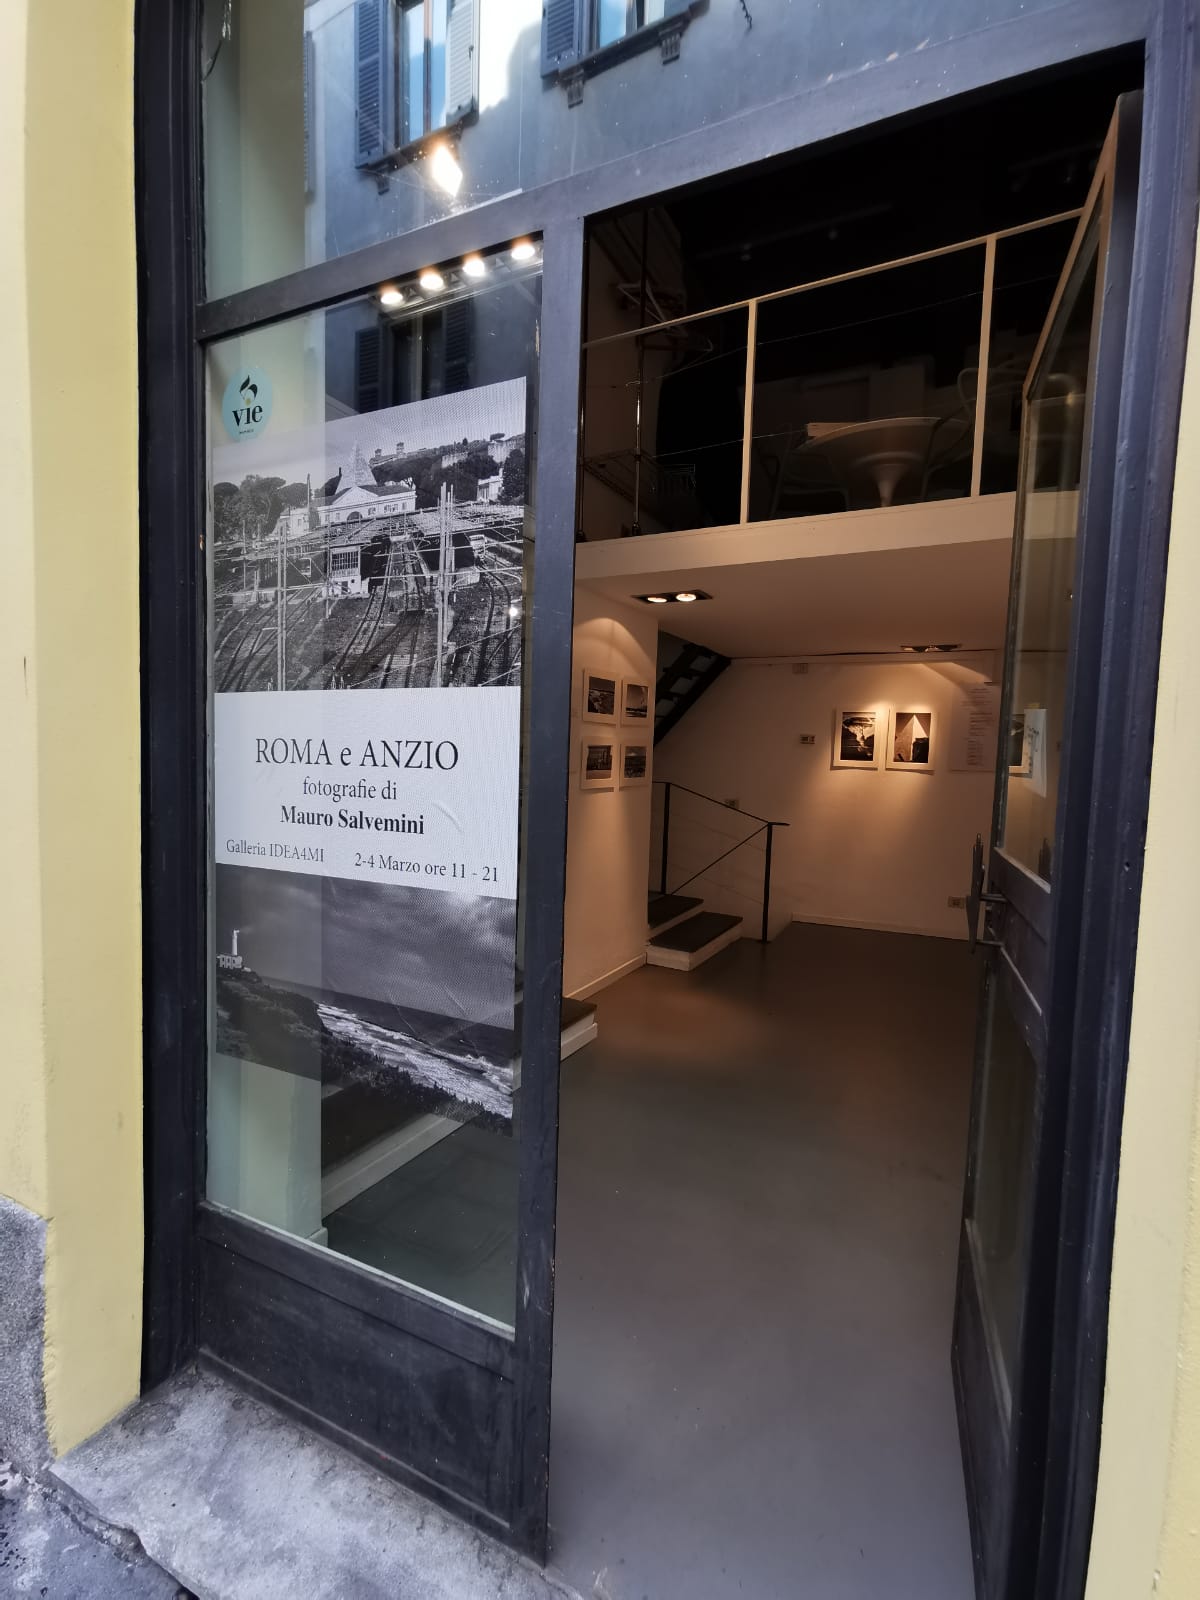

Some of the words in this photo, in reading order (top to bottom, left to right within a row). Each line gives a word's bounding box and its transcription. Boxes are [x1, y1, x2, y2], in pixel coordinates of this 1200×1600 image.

[255, 737, 333, 766] ROMA
[340, 746, 352, 766] e
[359, 739, 459, 770] ANZIO
[303, 776, 377, 802] fotografie
[381, 780, 397, 800] di
[280, 805, 333, 827] Mauro
[338, 808, 425, 835] Salvemini
[226, 839, 266, 857] Galleria
[269, 843, 324, 862] IDEA4MI
[354, 852, 375, 868] 2-4
[378, 854, 421, 874] Marzo
[424, 861, 447, 876] ore
[451, 863, 466, 878] 11
[482, 866, 499, 882] 21
